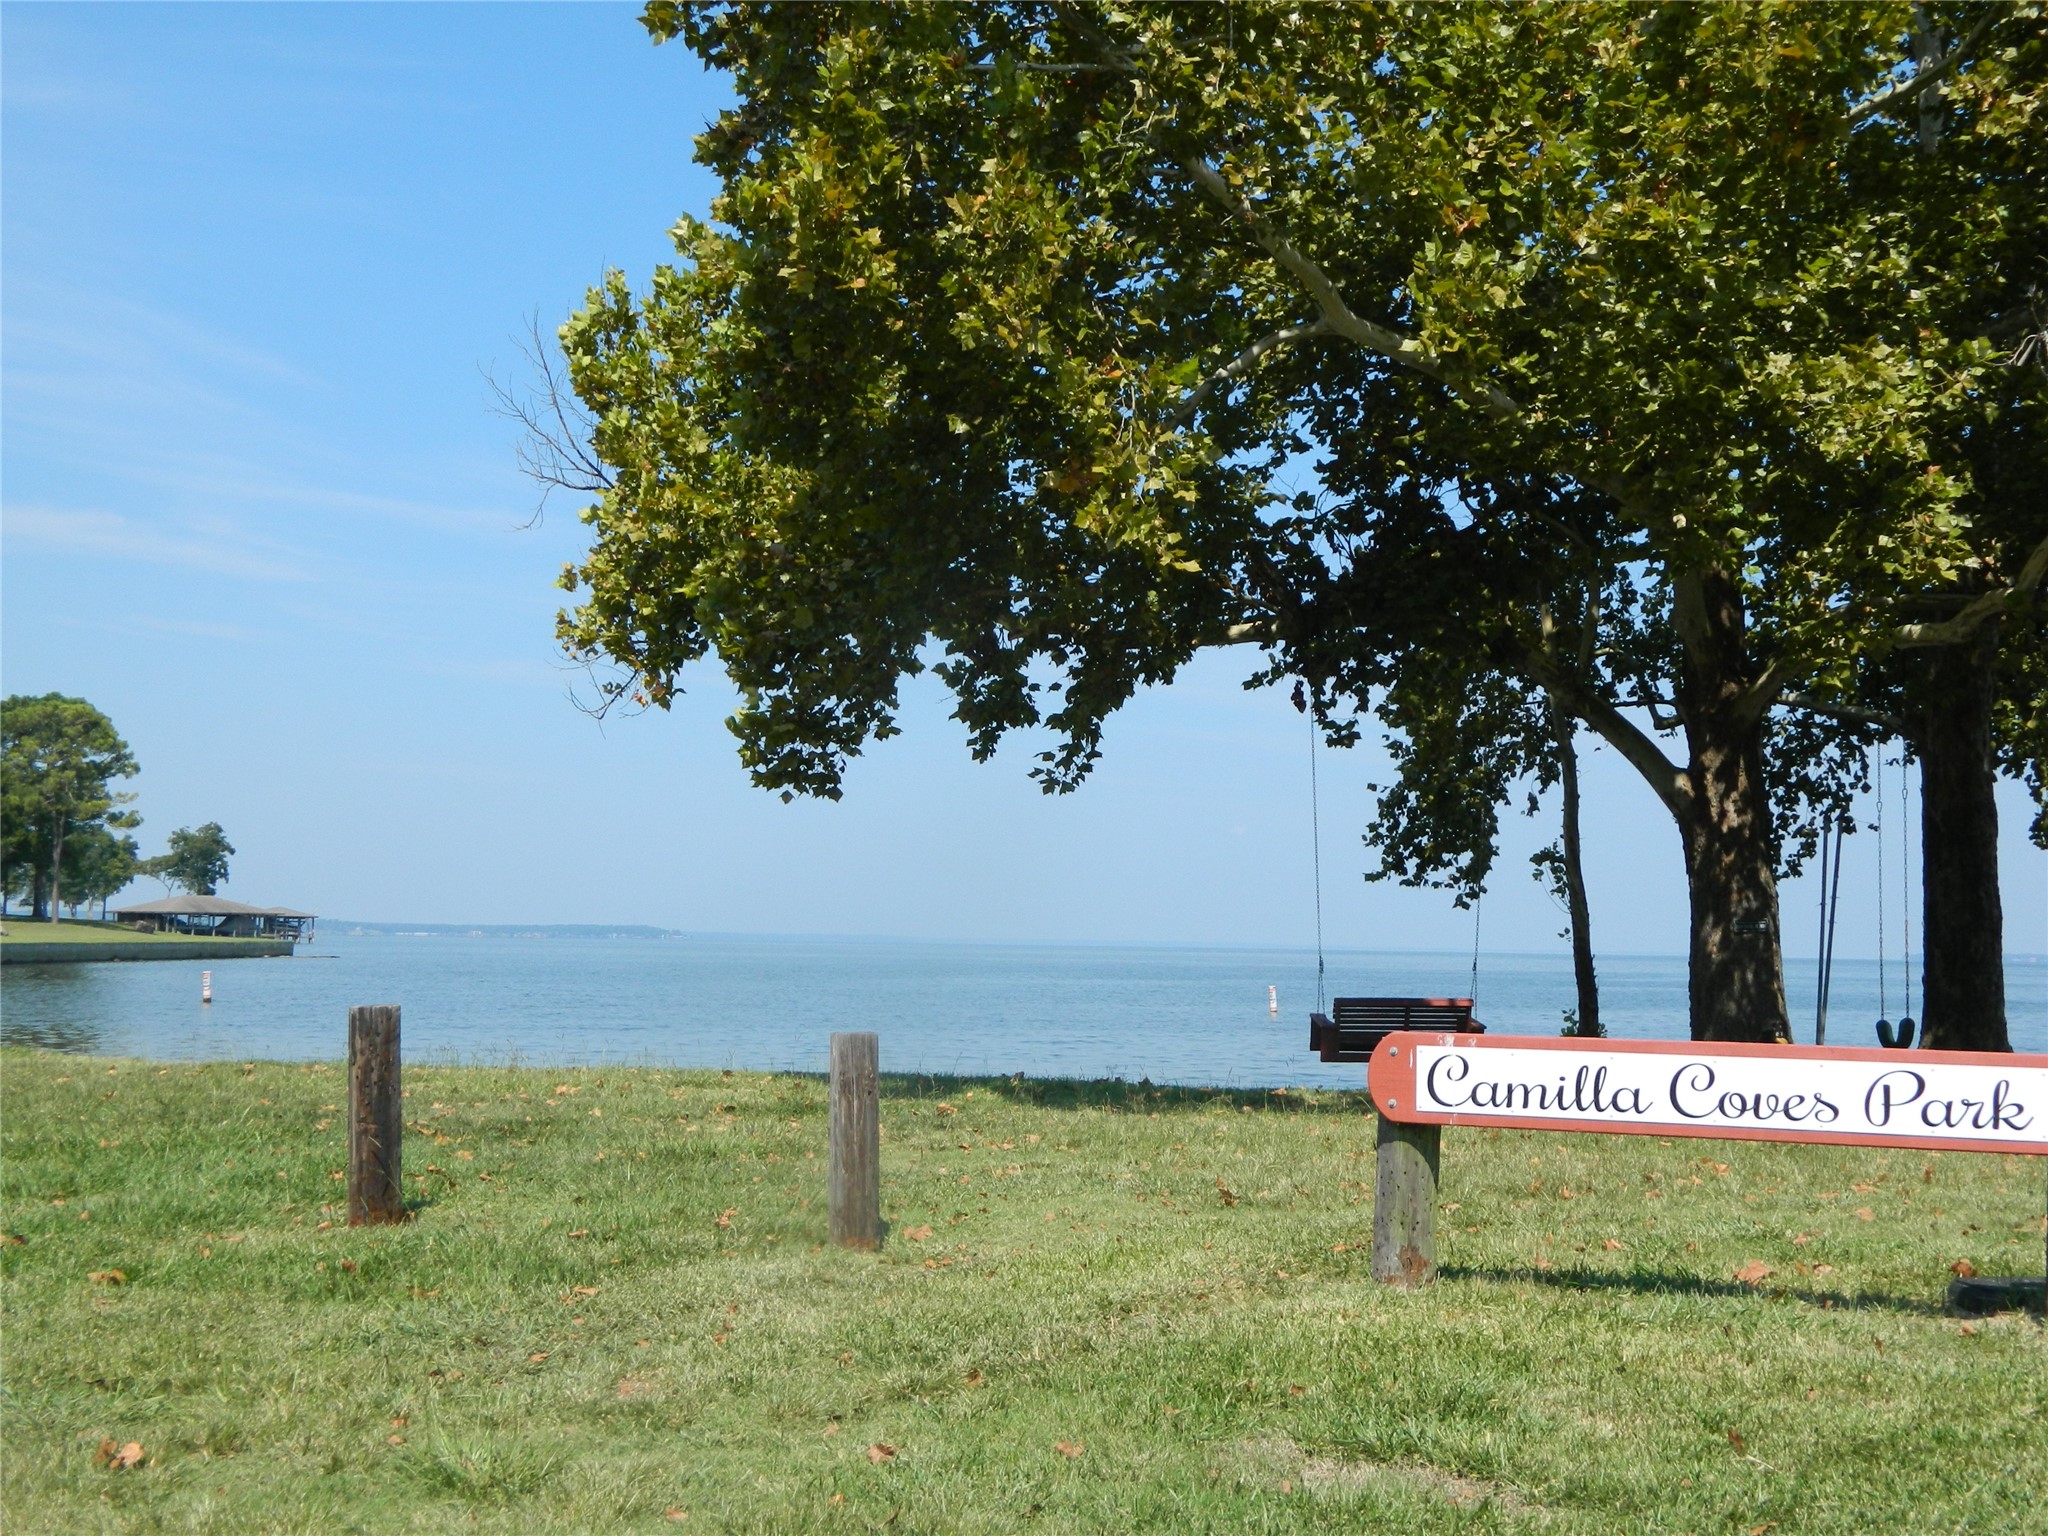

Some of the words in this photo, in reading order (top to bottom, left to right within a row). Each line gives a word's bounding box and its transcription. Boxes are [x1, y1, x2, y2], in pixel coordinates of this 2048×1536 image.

[1427, 1055, 1652, 1114] Camilla
[1669, 1063, 1839, 1121] Coves
[1864, 1071, 2033, 1130] Park
